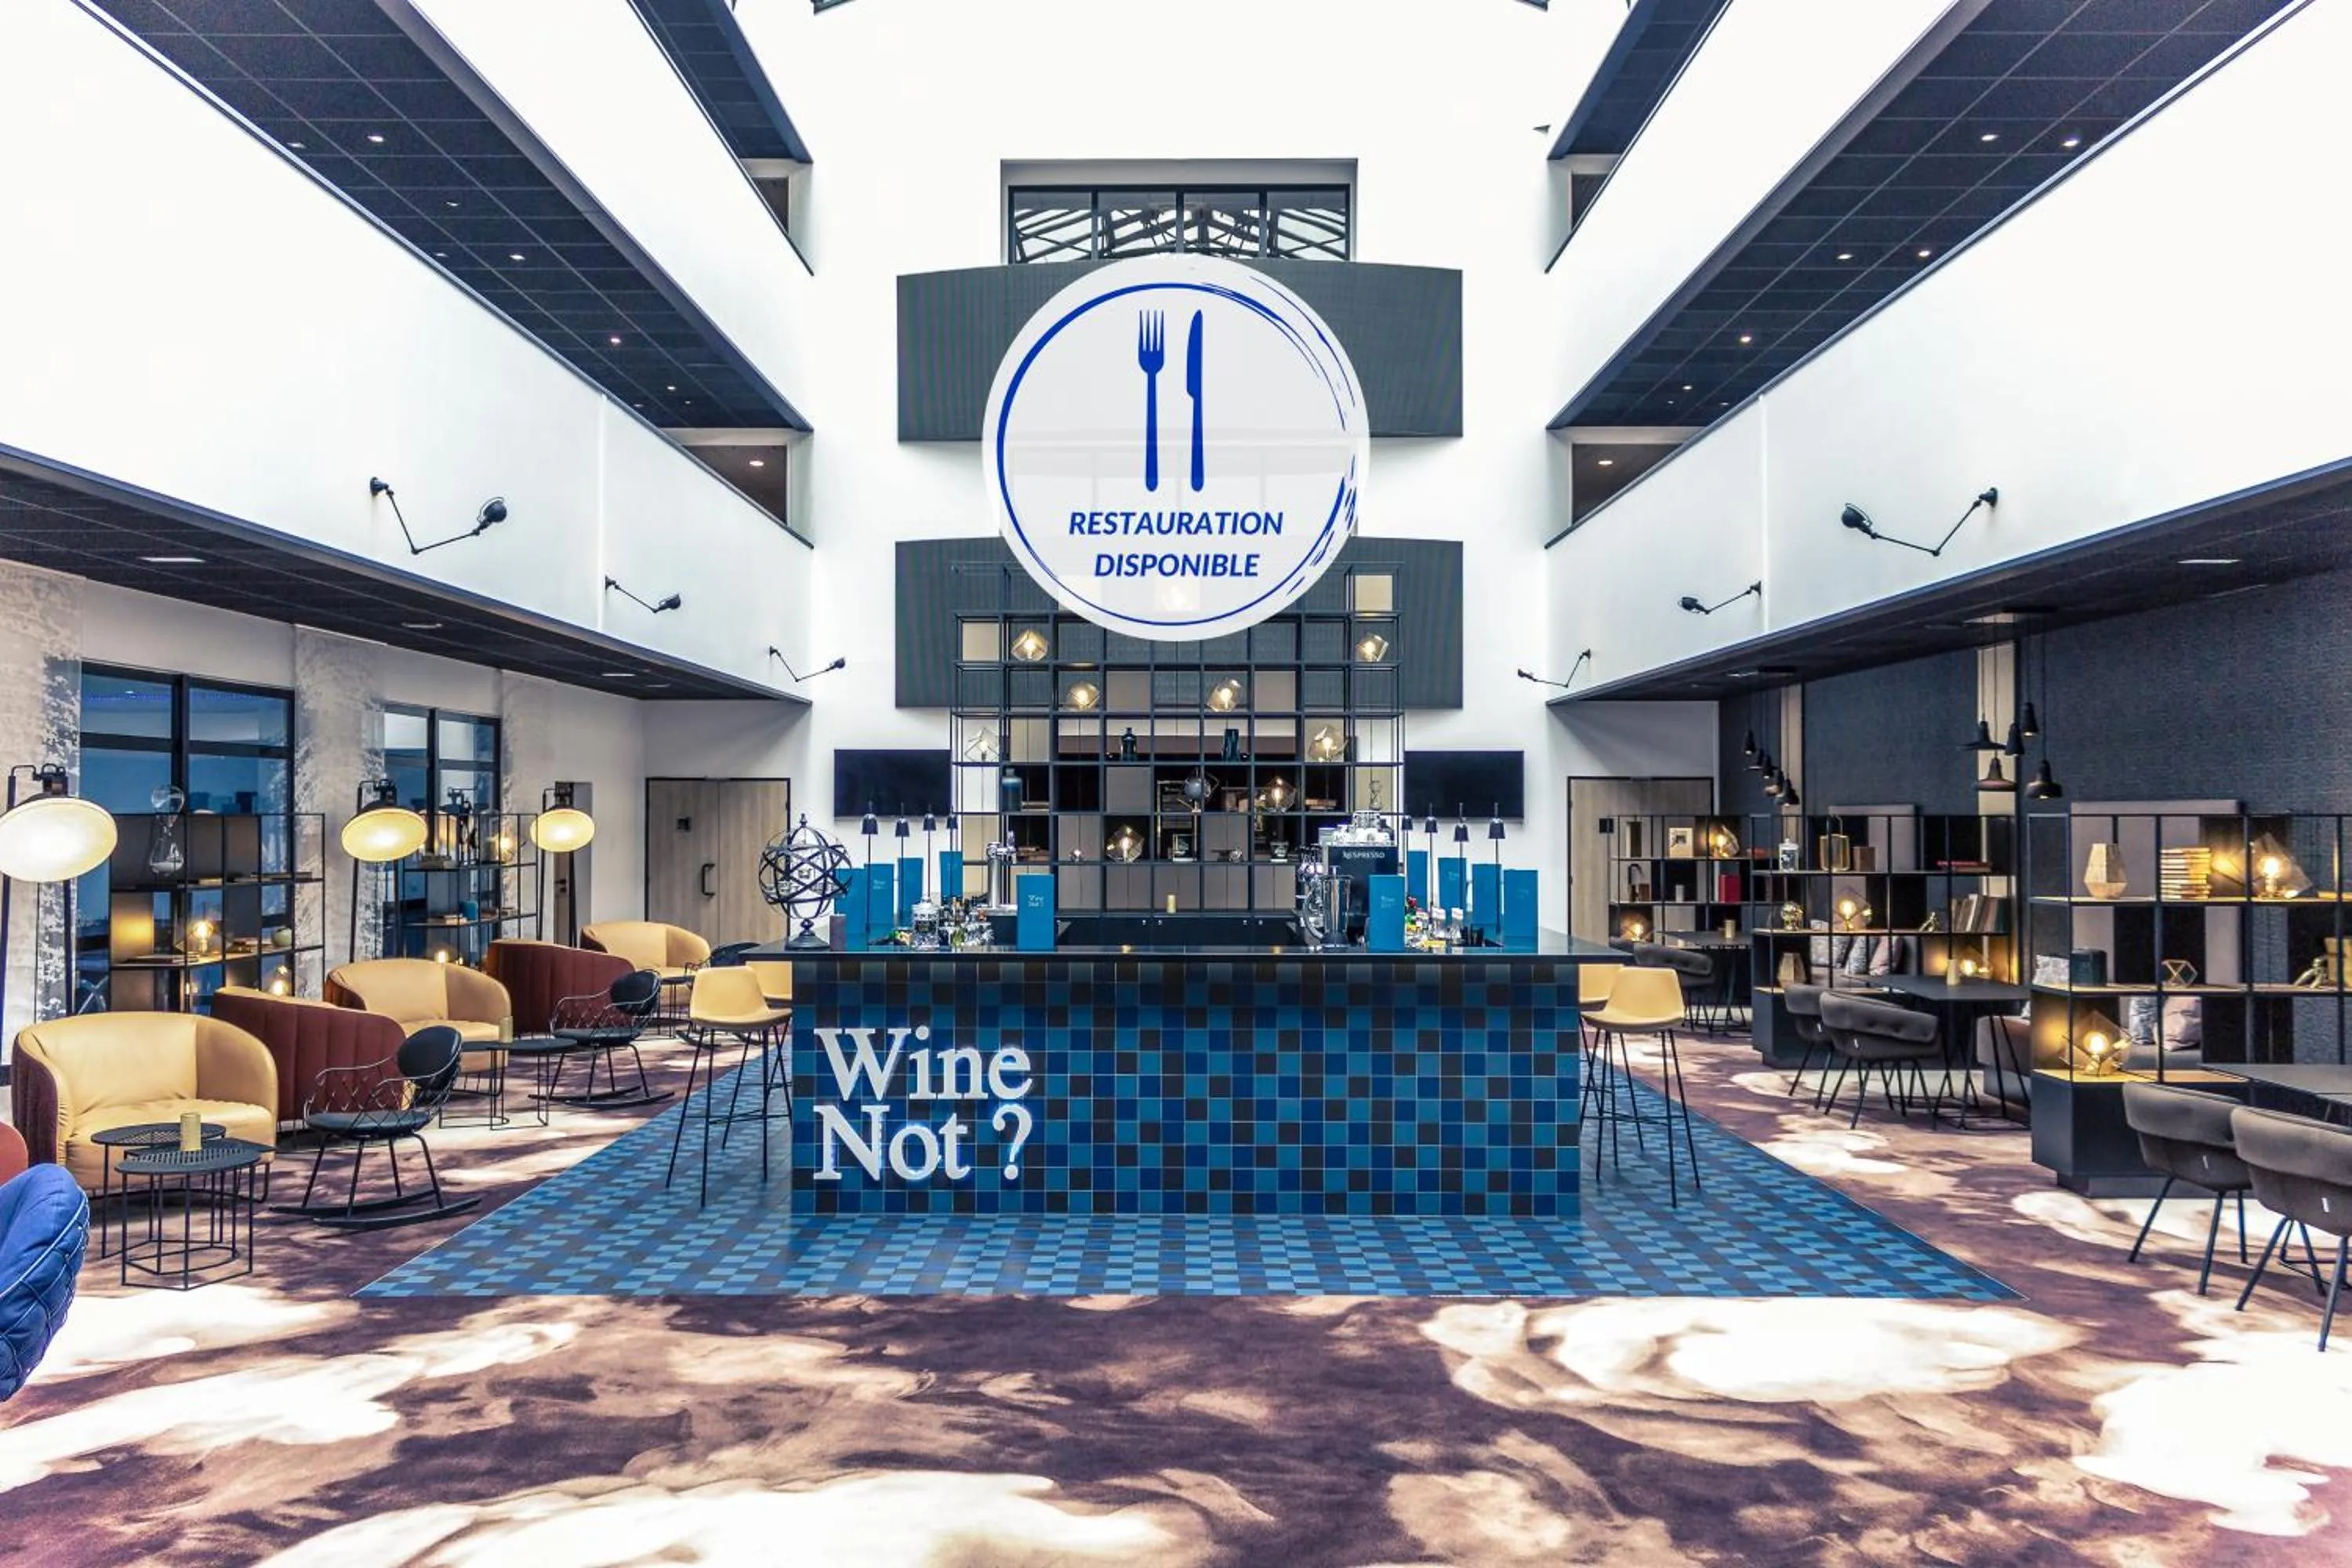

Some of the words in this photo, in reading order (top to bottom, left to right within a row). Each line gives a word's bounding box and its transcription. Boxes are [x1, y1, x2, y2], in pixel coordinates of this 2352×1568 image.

[814, 1025, 1033, 1101] Wine
[814, 1105, 971, 1180] Not
[993, 1103, 1033, 1180] ?
